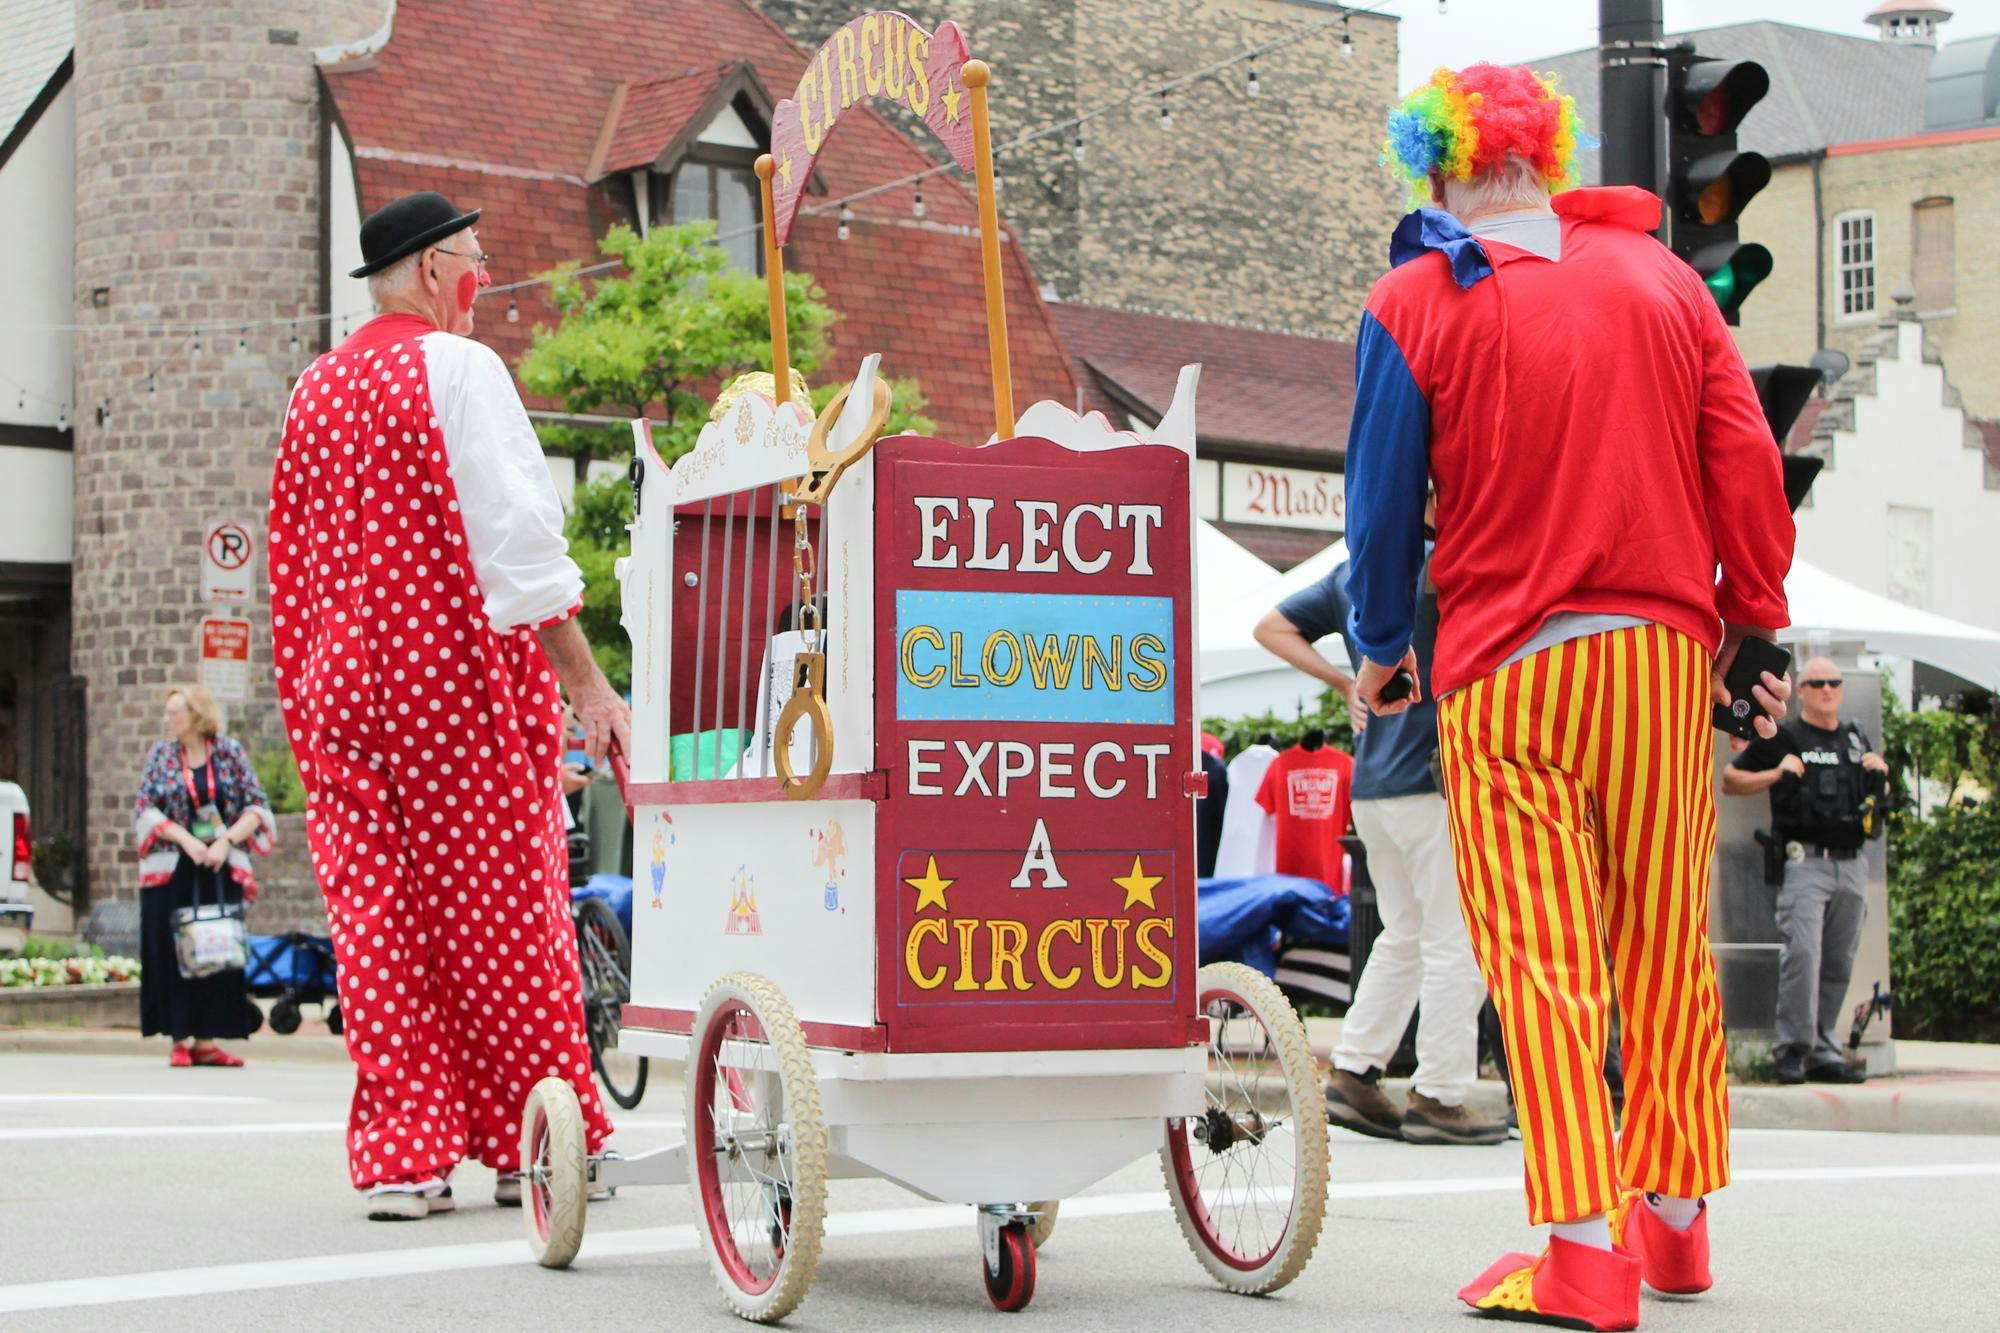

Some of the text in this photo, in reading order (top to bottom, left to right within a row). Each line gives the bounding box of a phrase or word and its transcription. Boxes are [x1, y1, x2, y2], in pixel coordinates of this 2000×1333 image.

[799, 15, 930, 156] CIRCUS
[1248, 469, 1343, 518] Made
[912, 496, 1163, 576] ELECT
[901, 625, 1167, 692] CLOWNS
[907, 739, 1171, 799] EXPECT
[1801, 751, 1839, 765] POLICE
[1010, 818, 1068, 888] A
[905, 917, 1174, 991] CIRCUS
